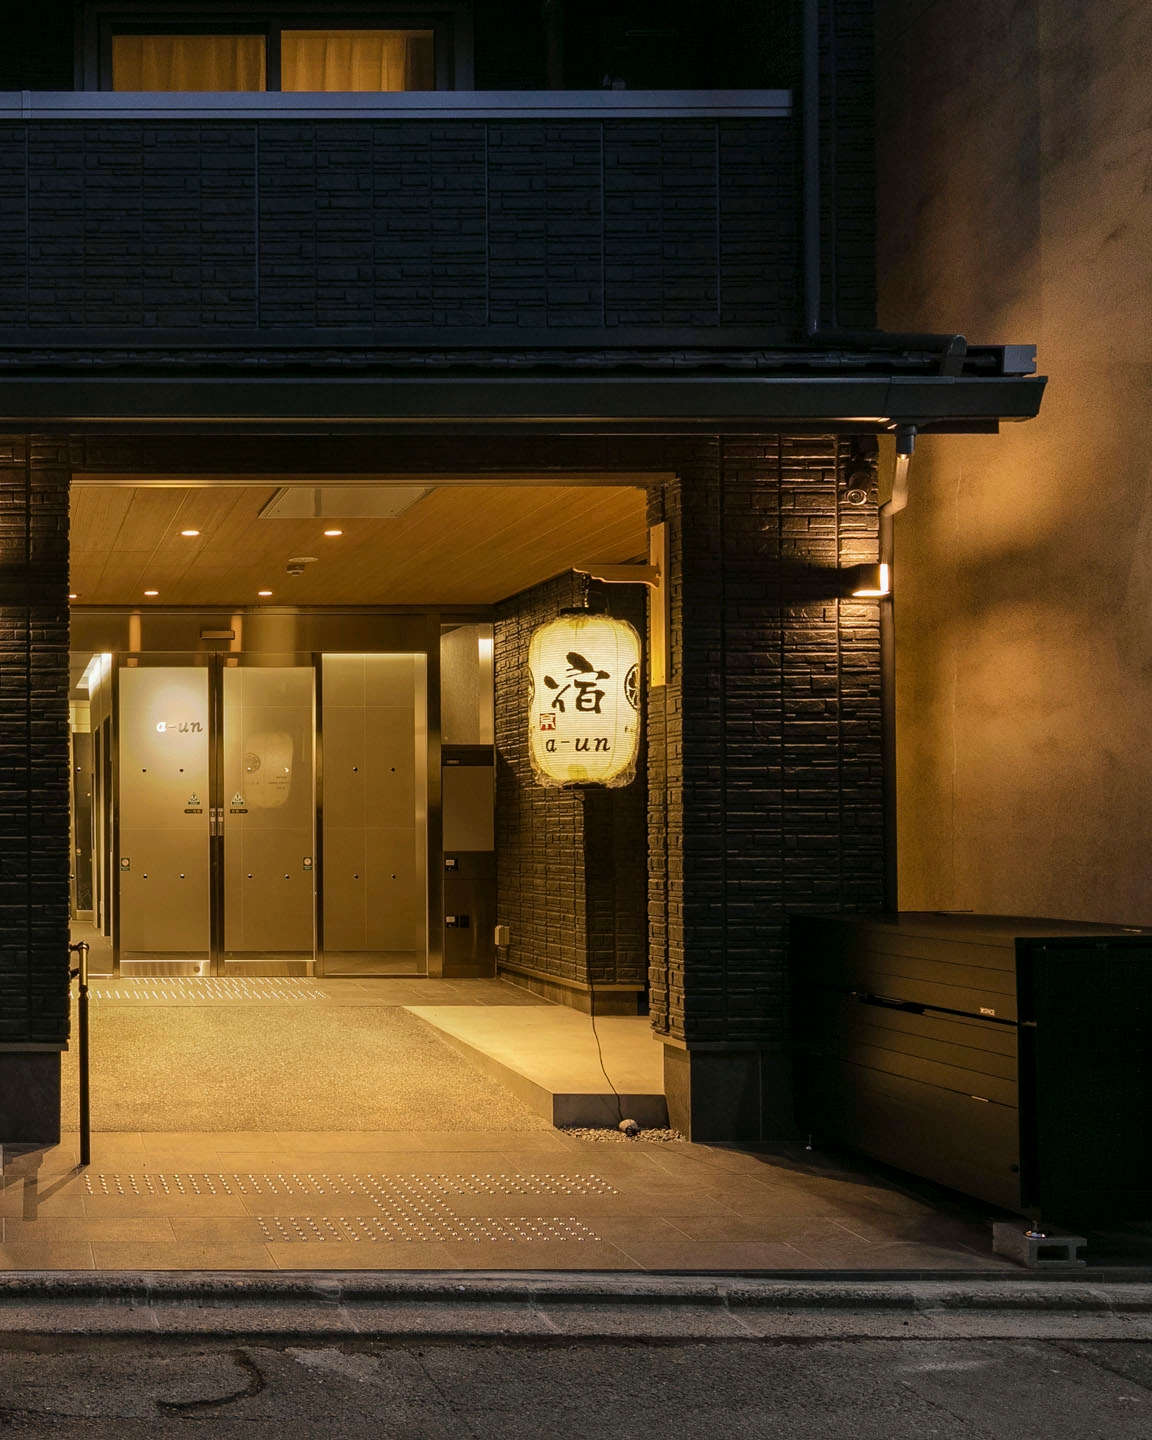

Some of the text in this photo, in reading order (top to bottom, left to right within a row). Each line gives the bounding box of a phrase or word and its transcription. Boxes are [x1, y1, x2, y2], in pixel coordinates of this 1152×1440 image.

[543, 651, 611, 714] 宿
[156, 721, 204, 733] a-un
[545, 737, 611, 753] a-un
